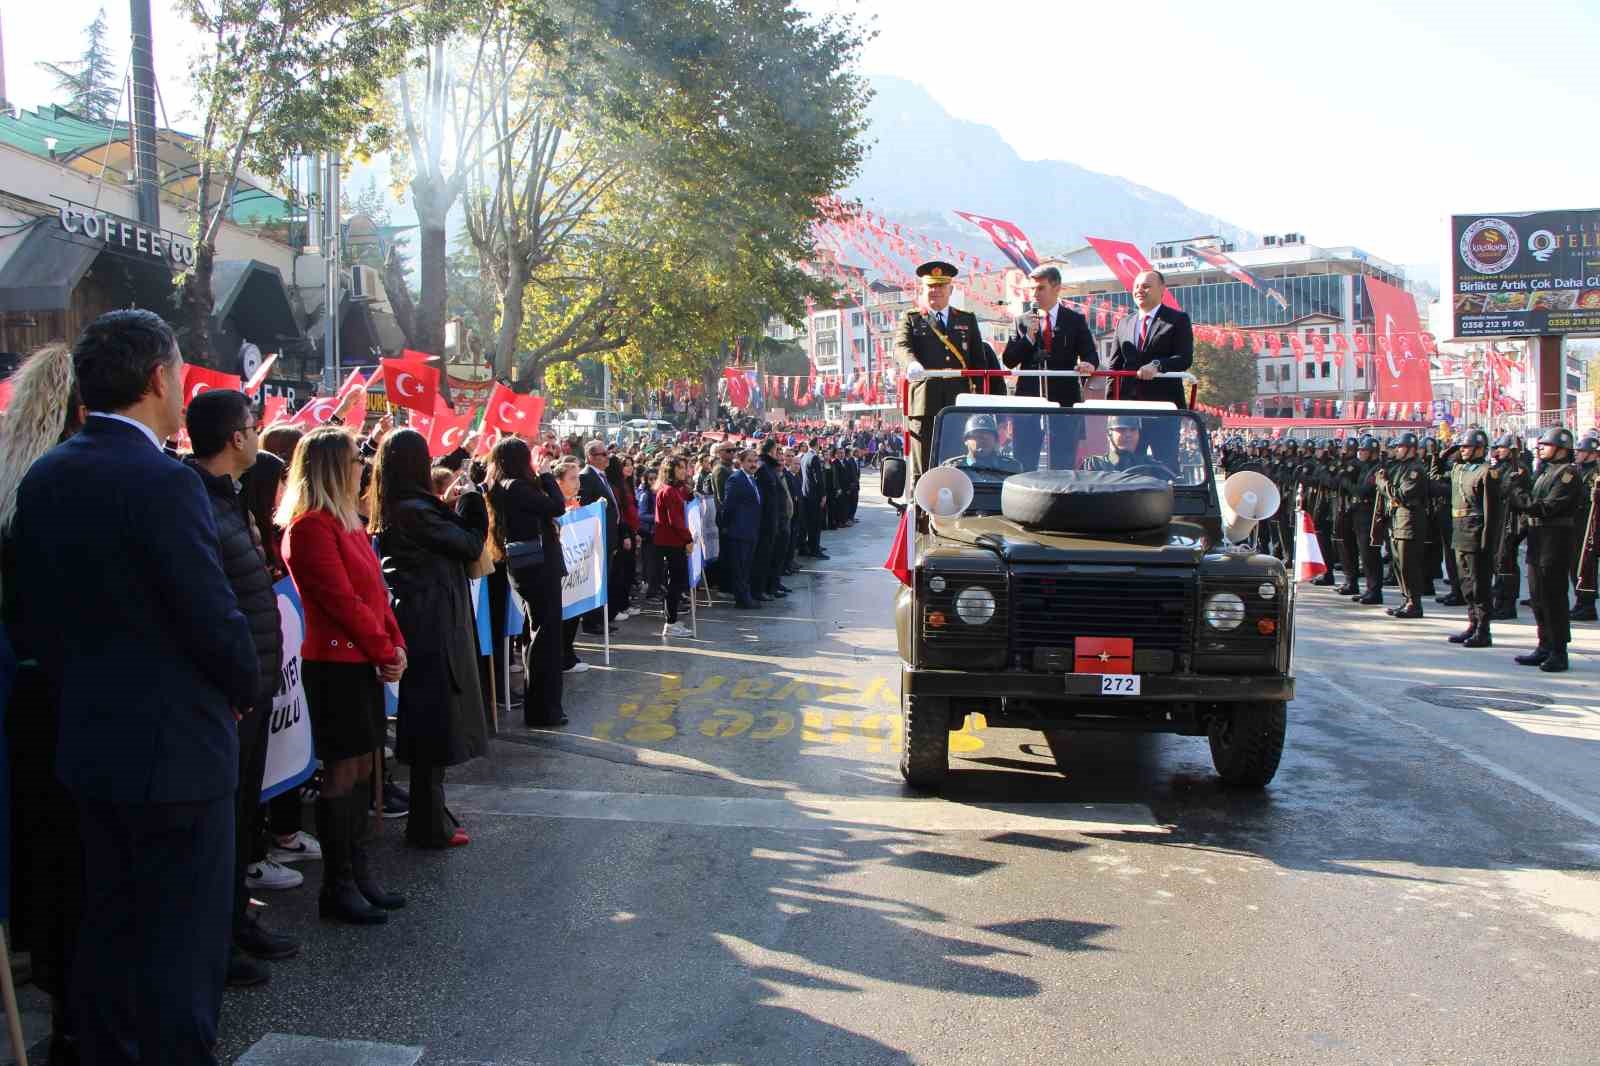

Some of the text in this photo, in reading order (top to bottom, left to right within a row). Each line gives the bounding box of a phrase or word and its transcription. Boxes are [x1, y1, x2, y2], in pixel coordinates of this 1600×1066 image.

[60, 206, 162, 257] COFFEE
[1460, 281, 1498, 291] Birlikte
[1554, 278, 1584, 288] Daha
[1103, 678, 1134, 691] 272
